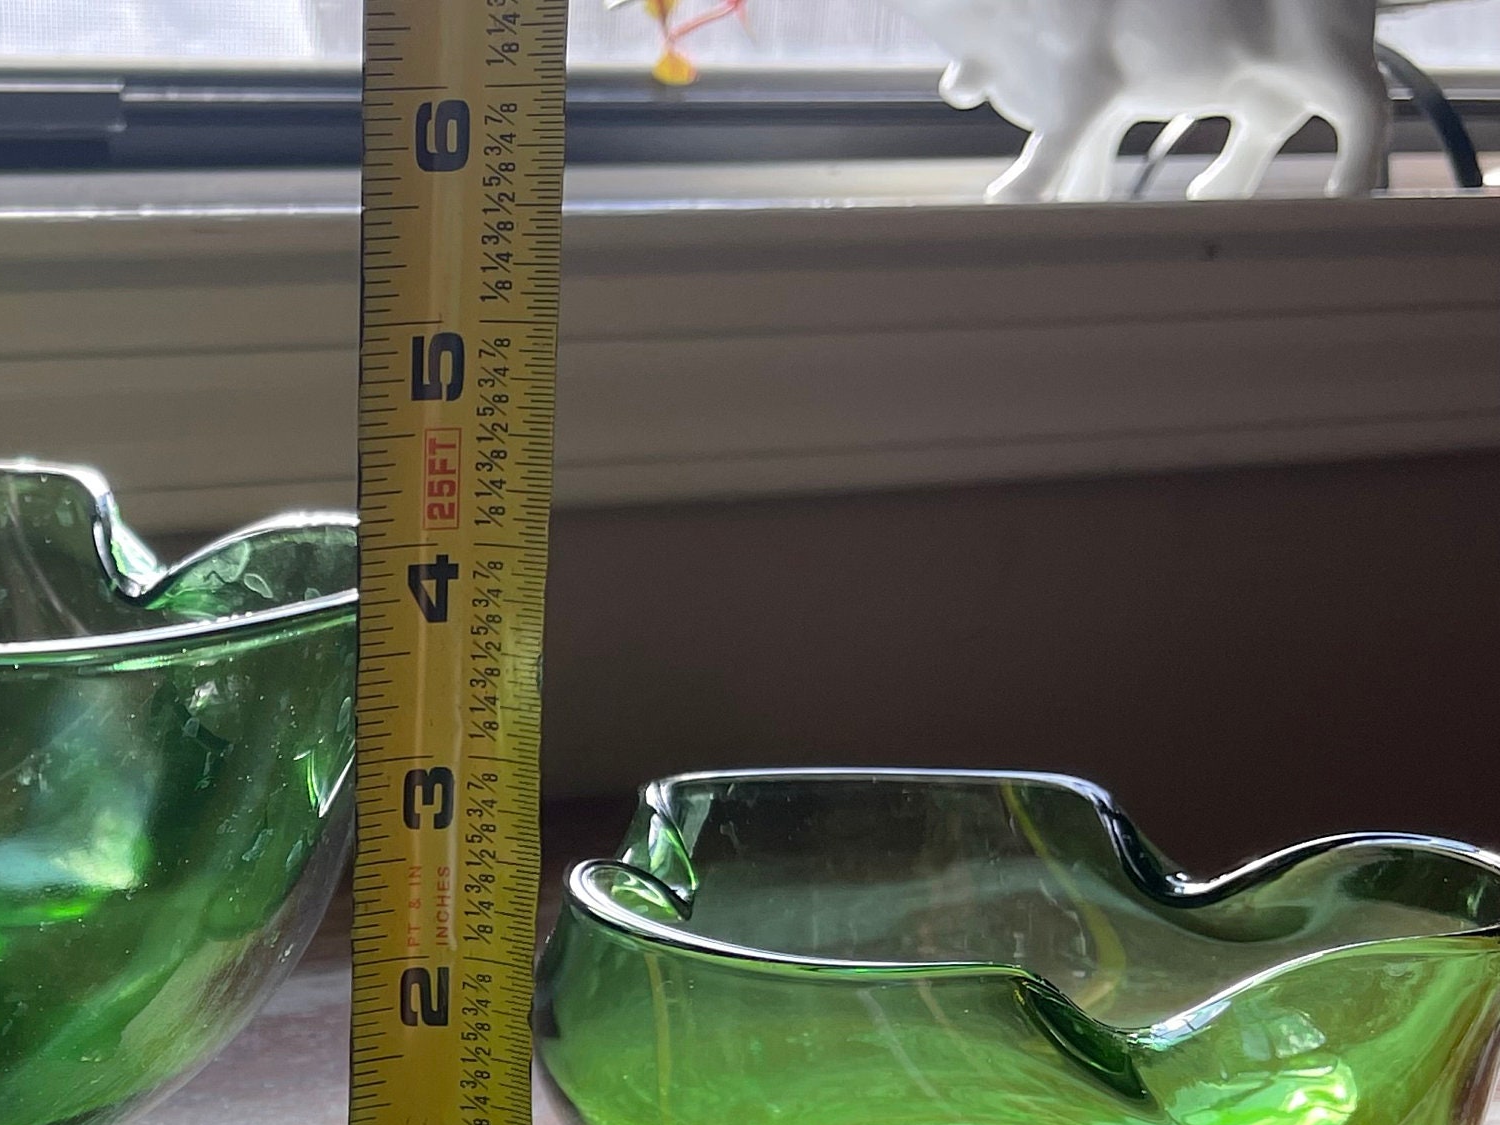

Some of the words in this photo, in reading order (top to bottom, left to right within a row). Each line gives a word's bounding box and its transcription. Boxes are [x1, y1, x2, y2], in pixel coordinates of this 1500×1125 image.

[487, 12, 520, 35] 1/4
[486, 42, 520, 66] 1/8
[484, 103, 518, 126] 7/8
[415, 100, 470, 172] 6
[483, 132, 517, 156] 3/4
[482, 162, 516, 187] 5/8
[481, 192, 516, 215] 1/2
[481, 221, 515, 245] 3/8
[480, 251, 513, 273] 1/4
[479, 280, 512, 303] 1/8
[478, 338, 511, 360] 7/8
[411, 332, 465, 401] 5
[477, 366, 510, 388] 3/4
[476, 394, 509, 416] 5/8
[476, 422, 509, 444] 1/2
[475, 450, 507, 472] 3/8
[427, 437, 457, 520] 25FT
[474, 478, 507, 499] 1/4
[474, 506, 506, 527] 1/8
[472, 561, 504, 582] 7/8
[408, 554, 459, 623] 4
[472, 587, 503, 608] 3/4
[470, 614, 502, 635] 5/8
[470, 641, 501, 662] 1/2
[470, 667, 501, 688] 3/8
[469, 694, 499, 715] 1/4
[468, 720, 499, 742] 1/8
[467, 772, 498, 793] 7/8
[403, 766, 455, 830] 3
[466, 797, 498, 818] 3/4
[465, 823, 496, 843] 5/8
[465, 849, 496, 869] 1/2
[409, 866, 422, 886] IN
[464, 873, 495, 894] 3/8
[436, 866, 450, 946] INCHES
[464, 899, 495, 919] 1/4
[463, 924, 494, 944] 1/8
[462, 973, 492, 993] 7/8
[400, 966, 450, 1027] 2
[461, 997, 491, 1017] 3/4
[461, 1021, 491, 1042] 5/8
[460, 1046, 491, 1066] 1/2
[460, 1069, 491, 1090] 3/8
[460, 1094, 490, 1114] 1/4
